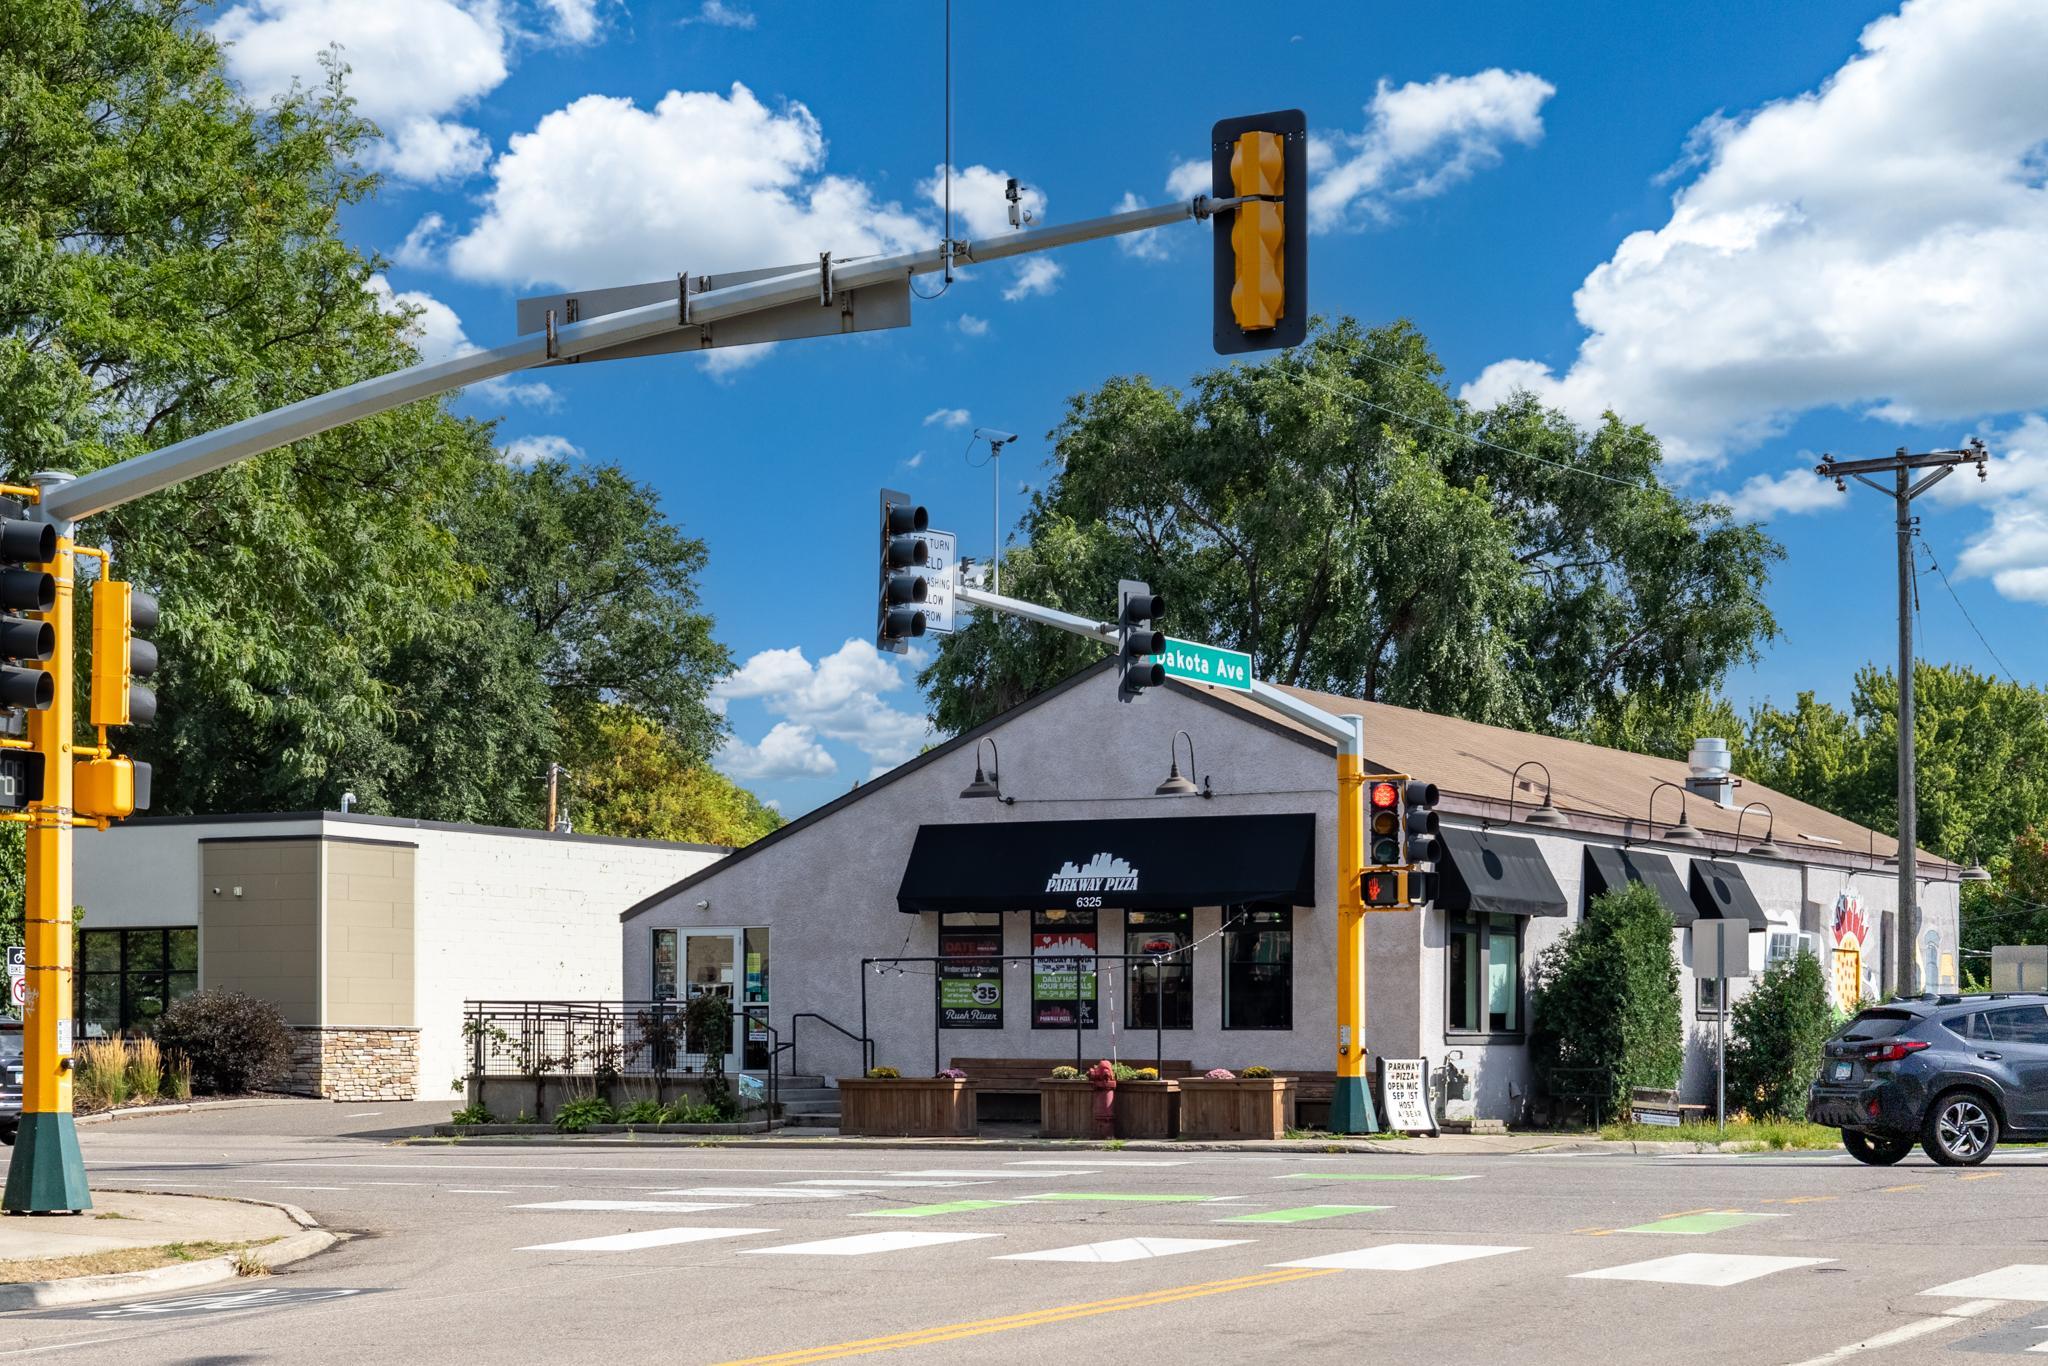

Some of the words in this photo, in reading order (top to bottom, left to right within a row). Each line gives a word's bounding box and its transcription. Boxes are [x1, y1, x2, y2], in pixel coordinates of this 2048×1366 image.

[930, 538, 950, 551] TURN
[926, 556, 943, 570] ELD
[927, 577, 950, 590] ASHING
[1217, 658, 1244, 681] Ave
[1045, 878, 1103, 892] PARKWAY
[1104, 877, 1139, 891] PIZZA
[1076, 896, 1102, 907] 6325
[972, 985, 997, 999] $35
[945, 1009, 970, 1020] Rush
[1388, 1062, 1420, 1071] PARKWAY
[1396, 1072, 1414, 1080] PIZZA
[1388, 1082, 1404, 1090] OPEN
[1407, 1082, 1418, 1090] MIC
[1392, 1092, 1404, 1100] SEP
